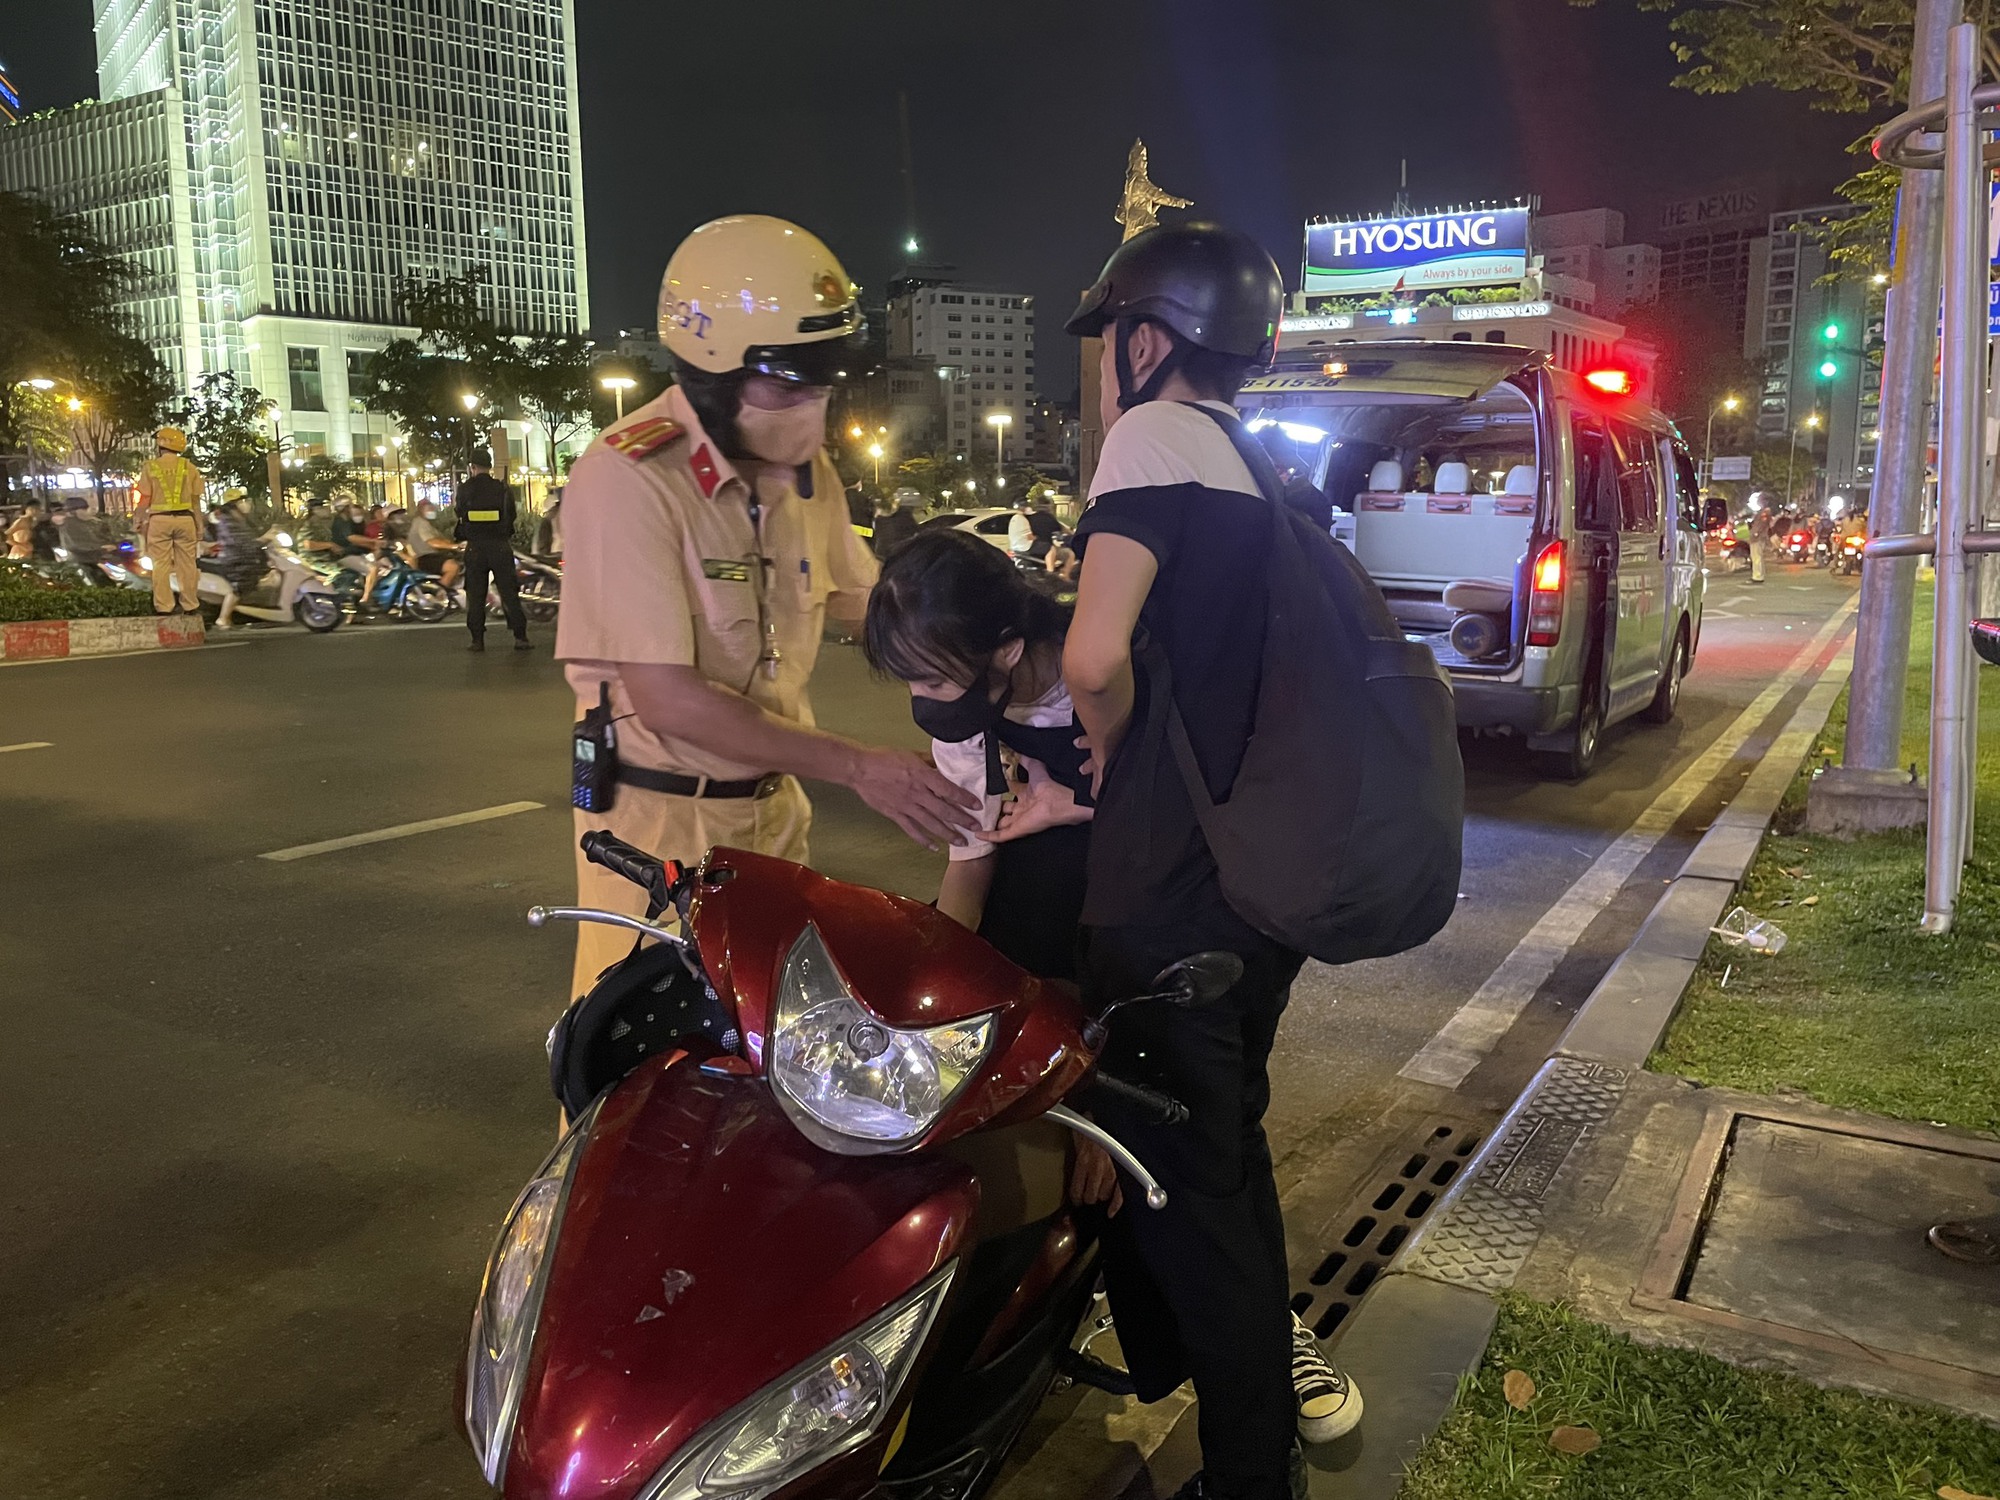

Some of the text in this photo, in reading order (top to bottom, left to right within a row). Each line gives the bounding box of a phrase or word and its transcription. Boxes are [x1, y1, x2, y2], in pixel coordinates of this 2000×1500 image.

[1333, 216, 1496, 257] HYOSUNG
[1423, 264, 1513, 279] Always by your side
